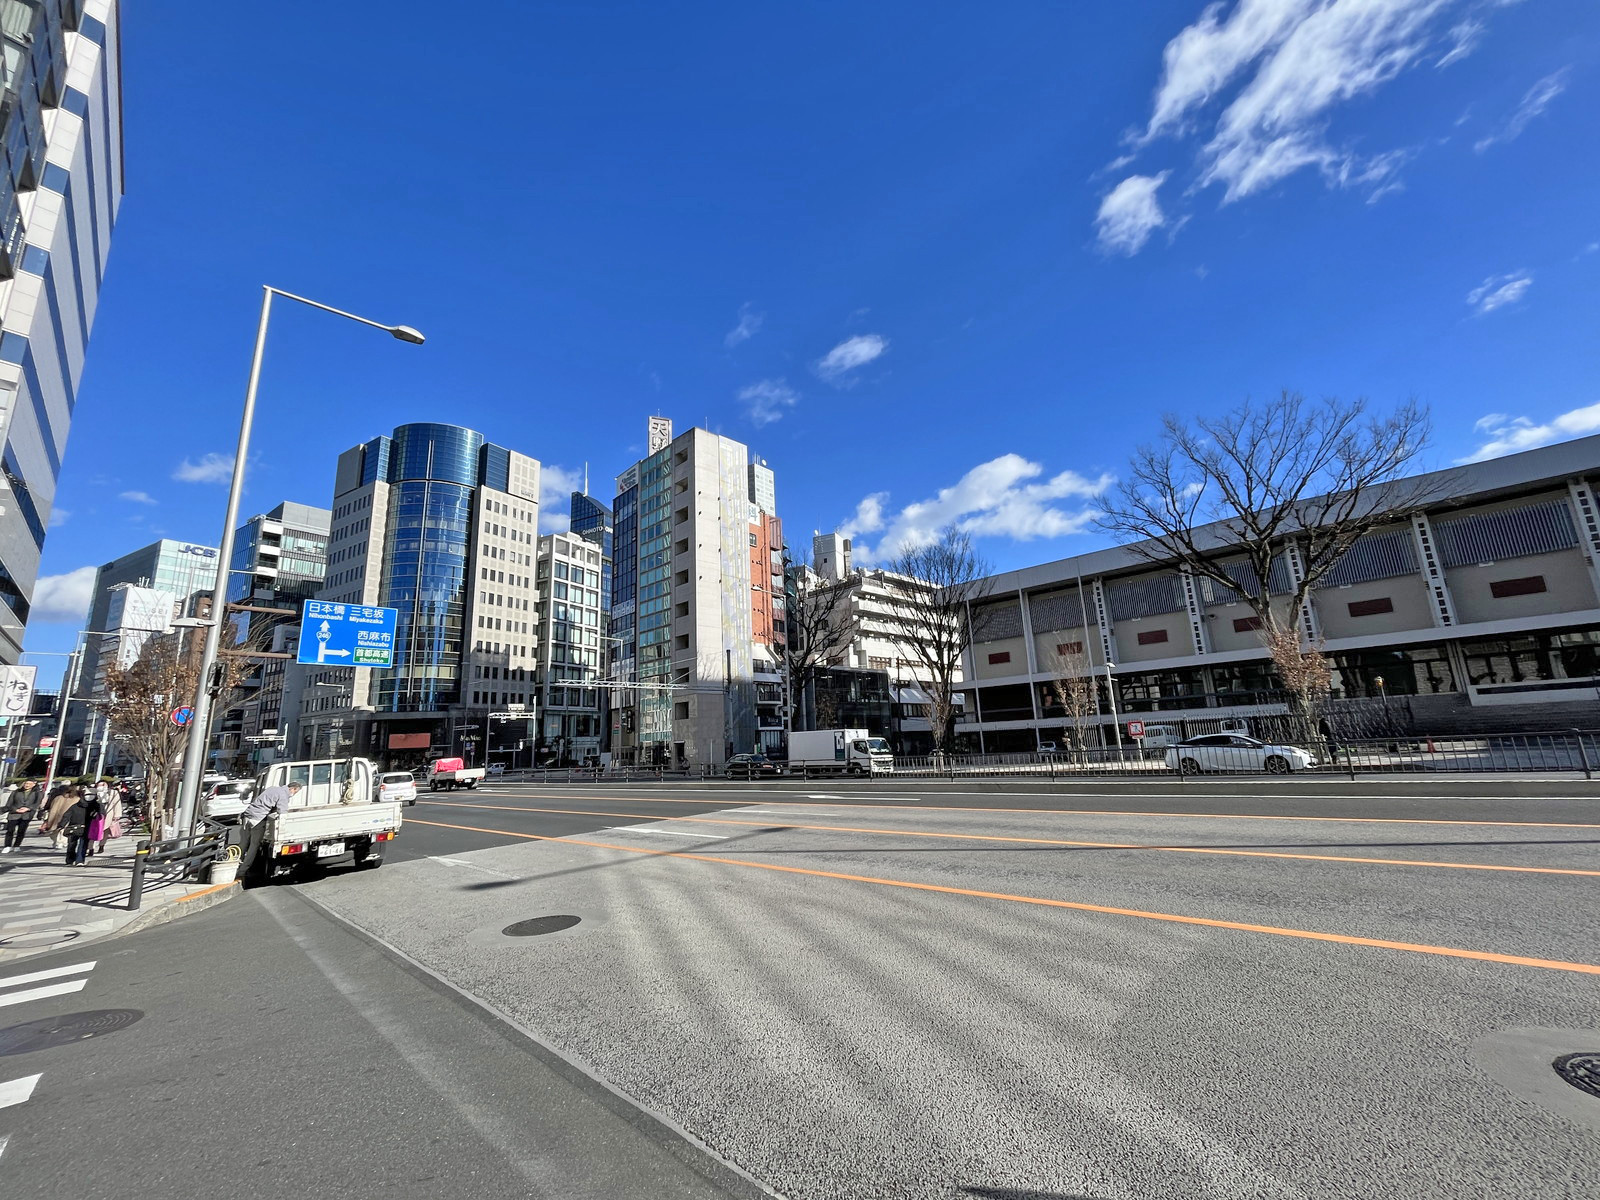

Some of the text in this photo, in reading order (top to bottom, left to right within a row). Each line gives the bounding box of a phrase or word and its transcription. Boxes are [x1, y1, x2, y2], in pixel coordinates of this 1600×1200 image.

[178, 545, 217, 558] JCB
[309, 602, 384, 618] 日本橋 三宅坂
[357, 630, 391, 642] 西麻布
[356, 649, 389, 658] 首都高速
